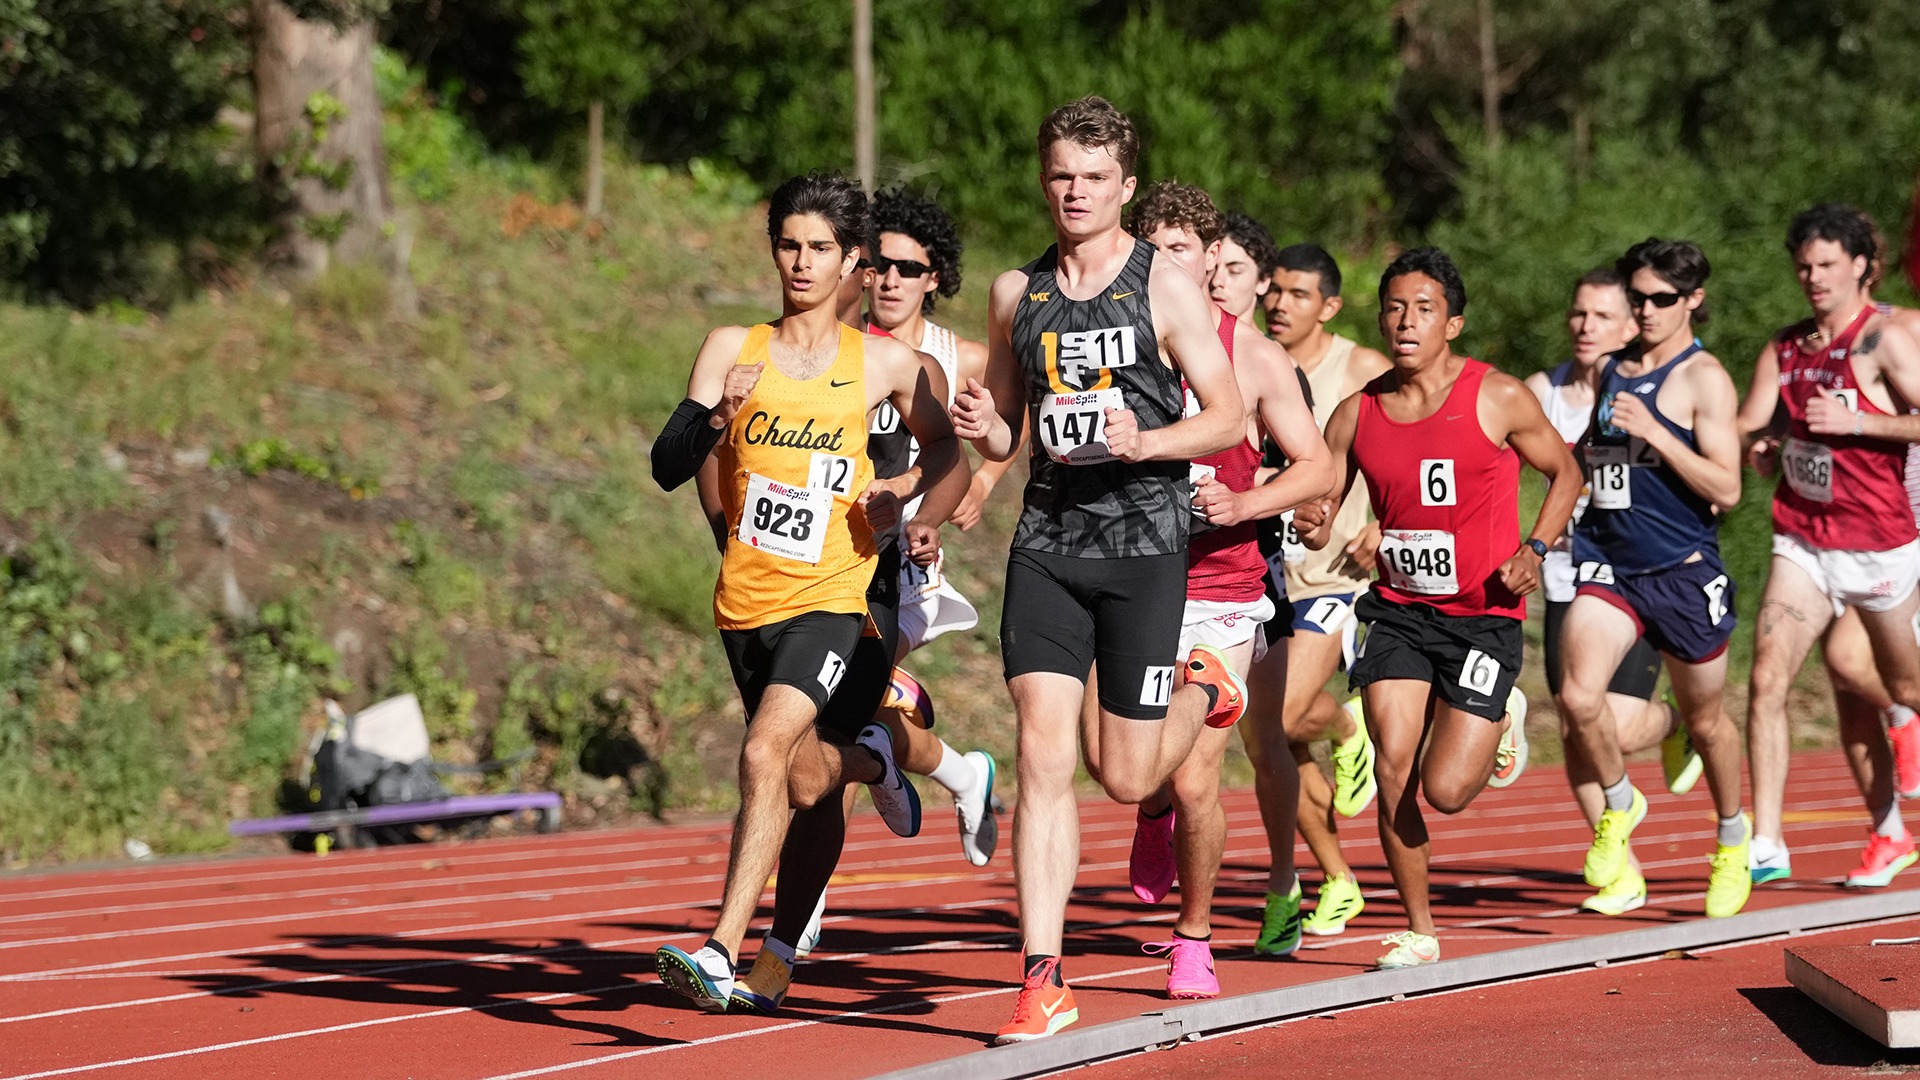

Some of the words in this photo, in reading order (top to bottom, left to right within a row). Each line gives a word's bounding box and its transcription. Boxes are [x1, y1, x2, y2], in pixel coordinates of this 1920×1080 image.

[1094, 330, 1125, 367] 11
[1055, 393, 1097, 407] MileSplit
[744, 410, 844, 452] Chabot
[1043, 411, 1117, 447] 147
[767, 482, 810, 501] MileSplit
[821, 456, 848, 493] 12
[1427, 462, 1447, 502] 6
[753, 497, 814, 541] 923
[1384, 547, 1452, 577] 1948
[828, 659, 845, 688] 1
[1471, 652, 1490, 687] 6
